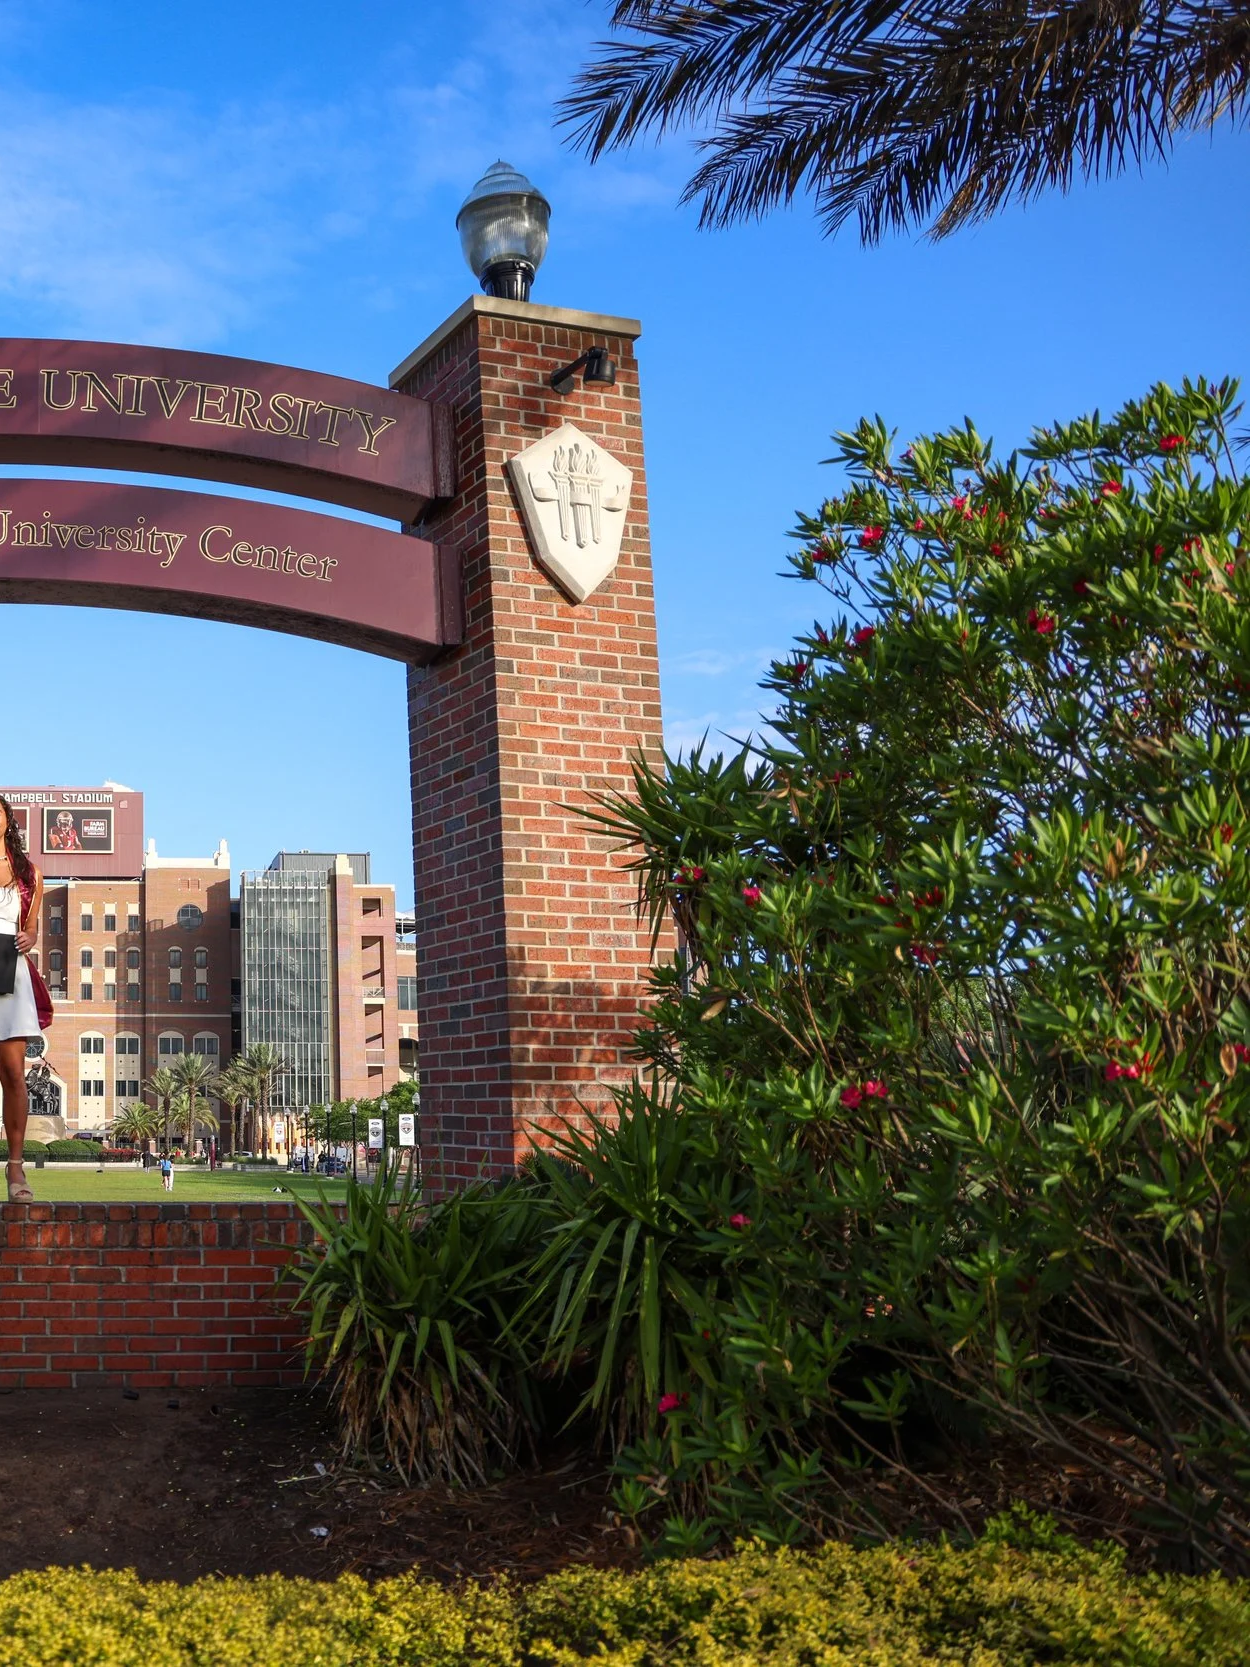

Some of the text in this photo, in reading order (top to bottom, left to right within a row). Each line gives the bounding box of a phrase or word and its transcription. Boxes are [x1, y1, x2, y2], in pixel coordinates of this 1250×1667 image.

[40, 369, 397, 456] UNIVERSITY
[199, 525, 338, 582] Center
[0, 793, 56, 803] AMPBELL
[62, 793, 113, 803] STADIUM
